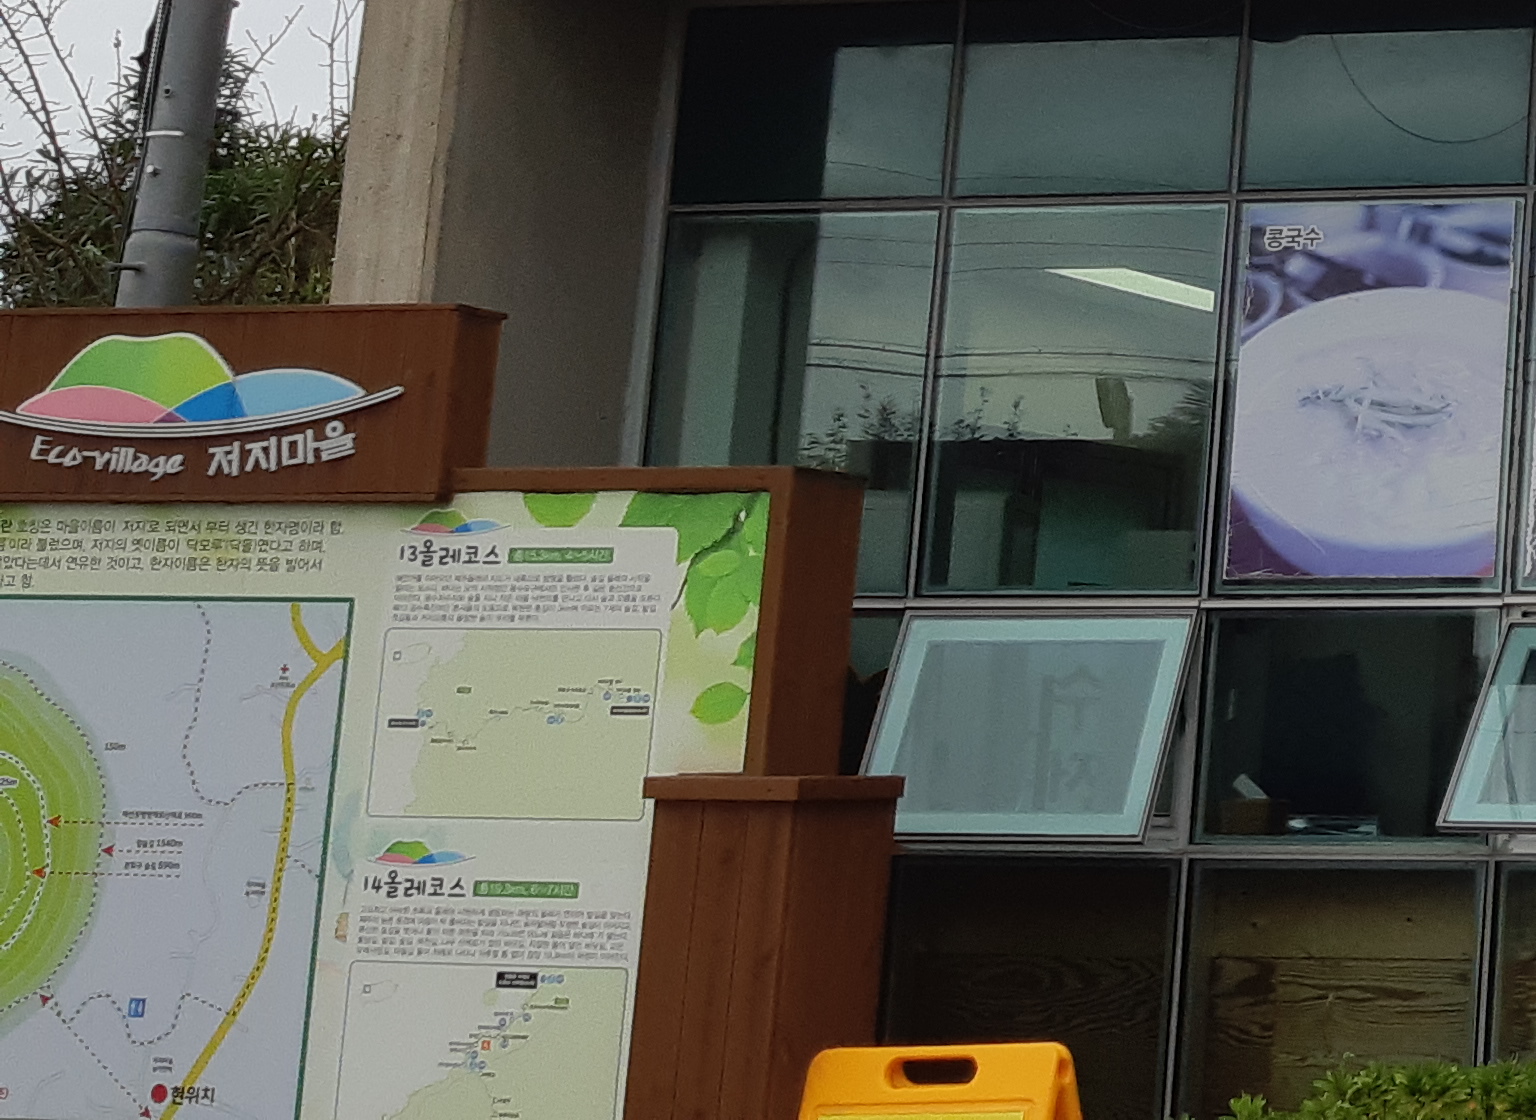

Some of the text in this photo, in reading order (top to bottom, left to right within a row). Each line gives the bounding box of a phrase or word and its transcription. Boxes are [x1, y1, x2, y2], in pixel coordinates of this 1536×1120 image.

[1265, 226, 1323, 250] 콩국수
[207, 420, 356, 478] 저지마을
[399, 538, 502, 567] 13올레코스
[362, 869, 467, 899] 14올레코스
[171, 1085, 216, 1106] 현위치
